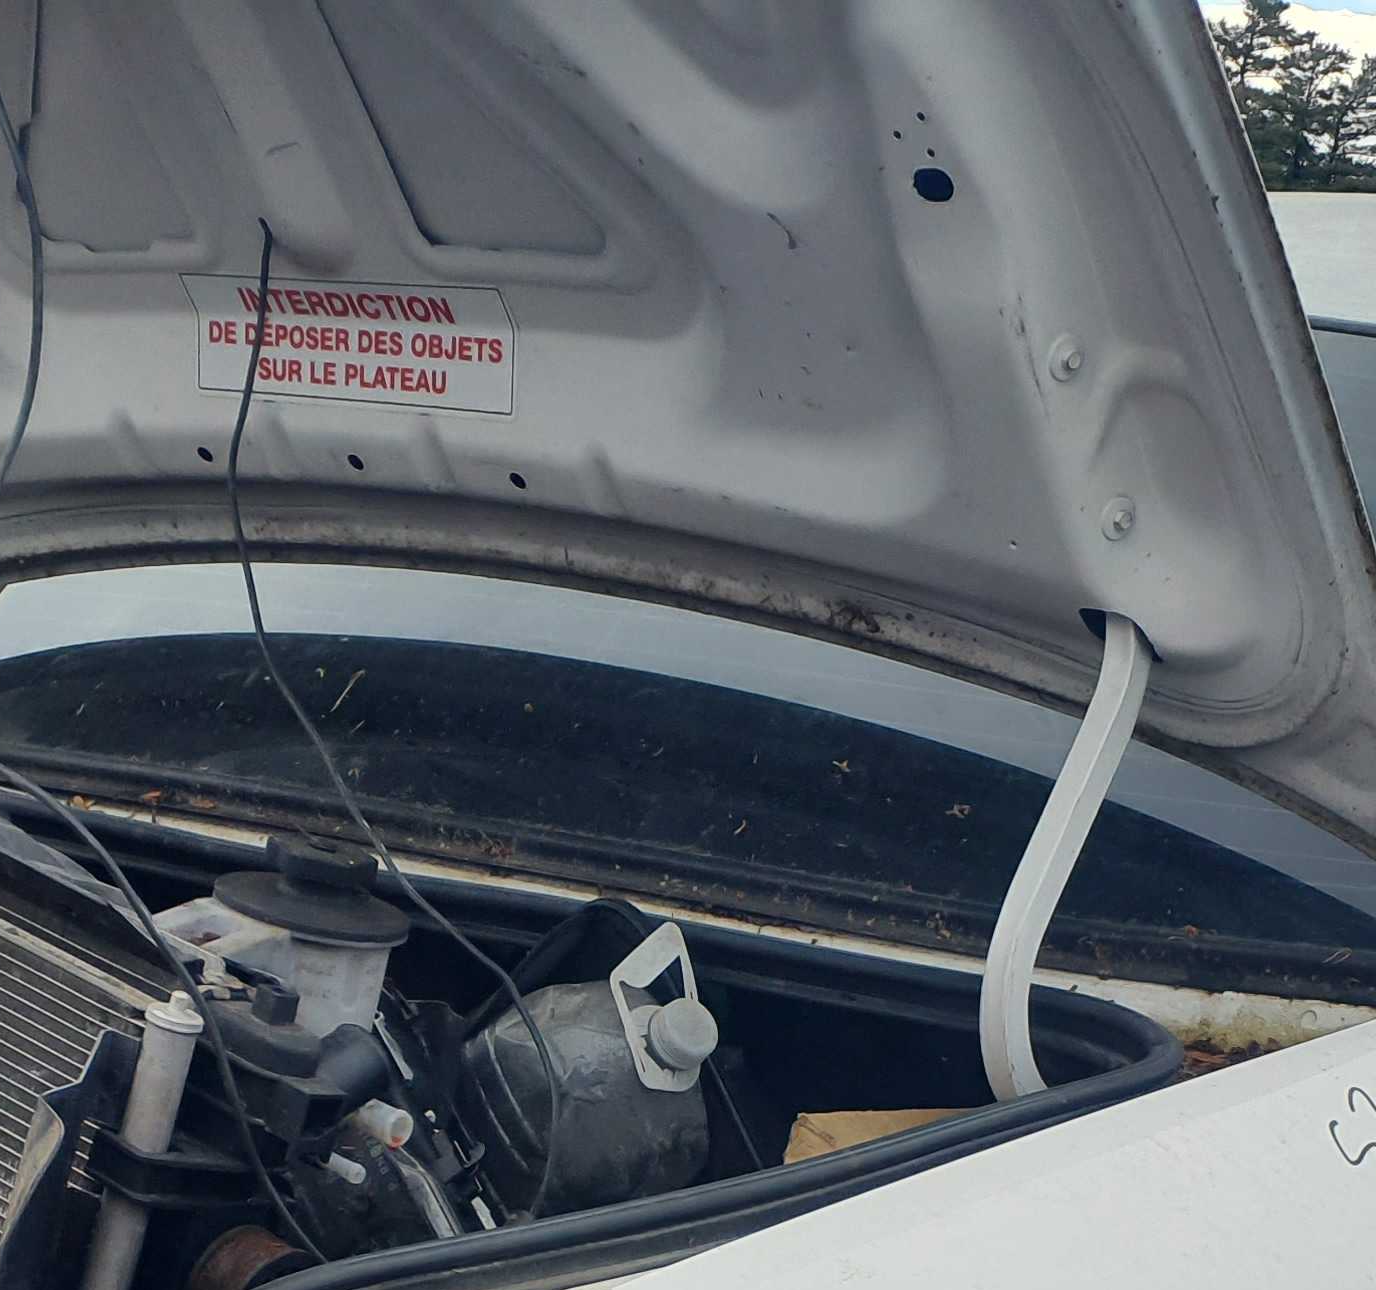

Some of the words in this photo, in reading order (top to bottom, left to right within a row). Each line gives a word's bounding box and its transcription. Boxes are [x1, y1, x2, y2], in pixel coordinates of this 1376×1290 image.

[236, 287, 456, 325] INTERDICTION
[208, 320, 237, 344] DE
[358, 329, 403, 356] DES
[411, 333, 503, 363] OBJETS
[258, 357, 302, 382] SUR
[310, 361, 337, 386] LE
[344, 363, 447, 394] PLATEAU
